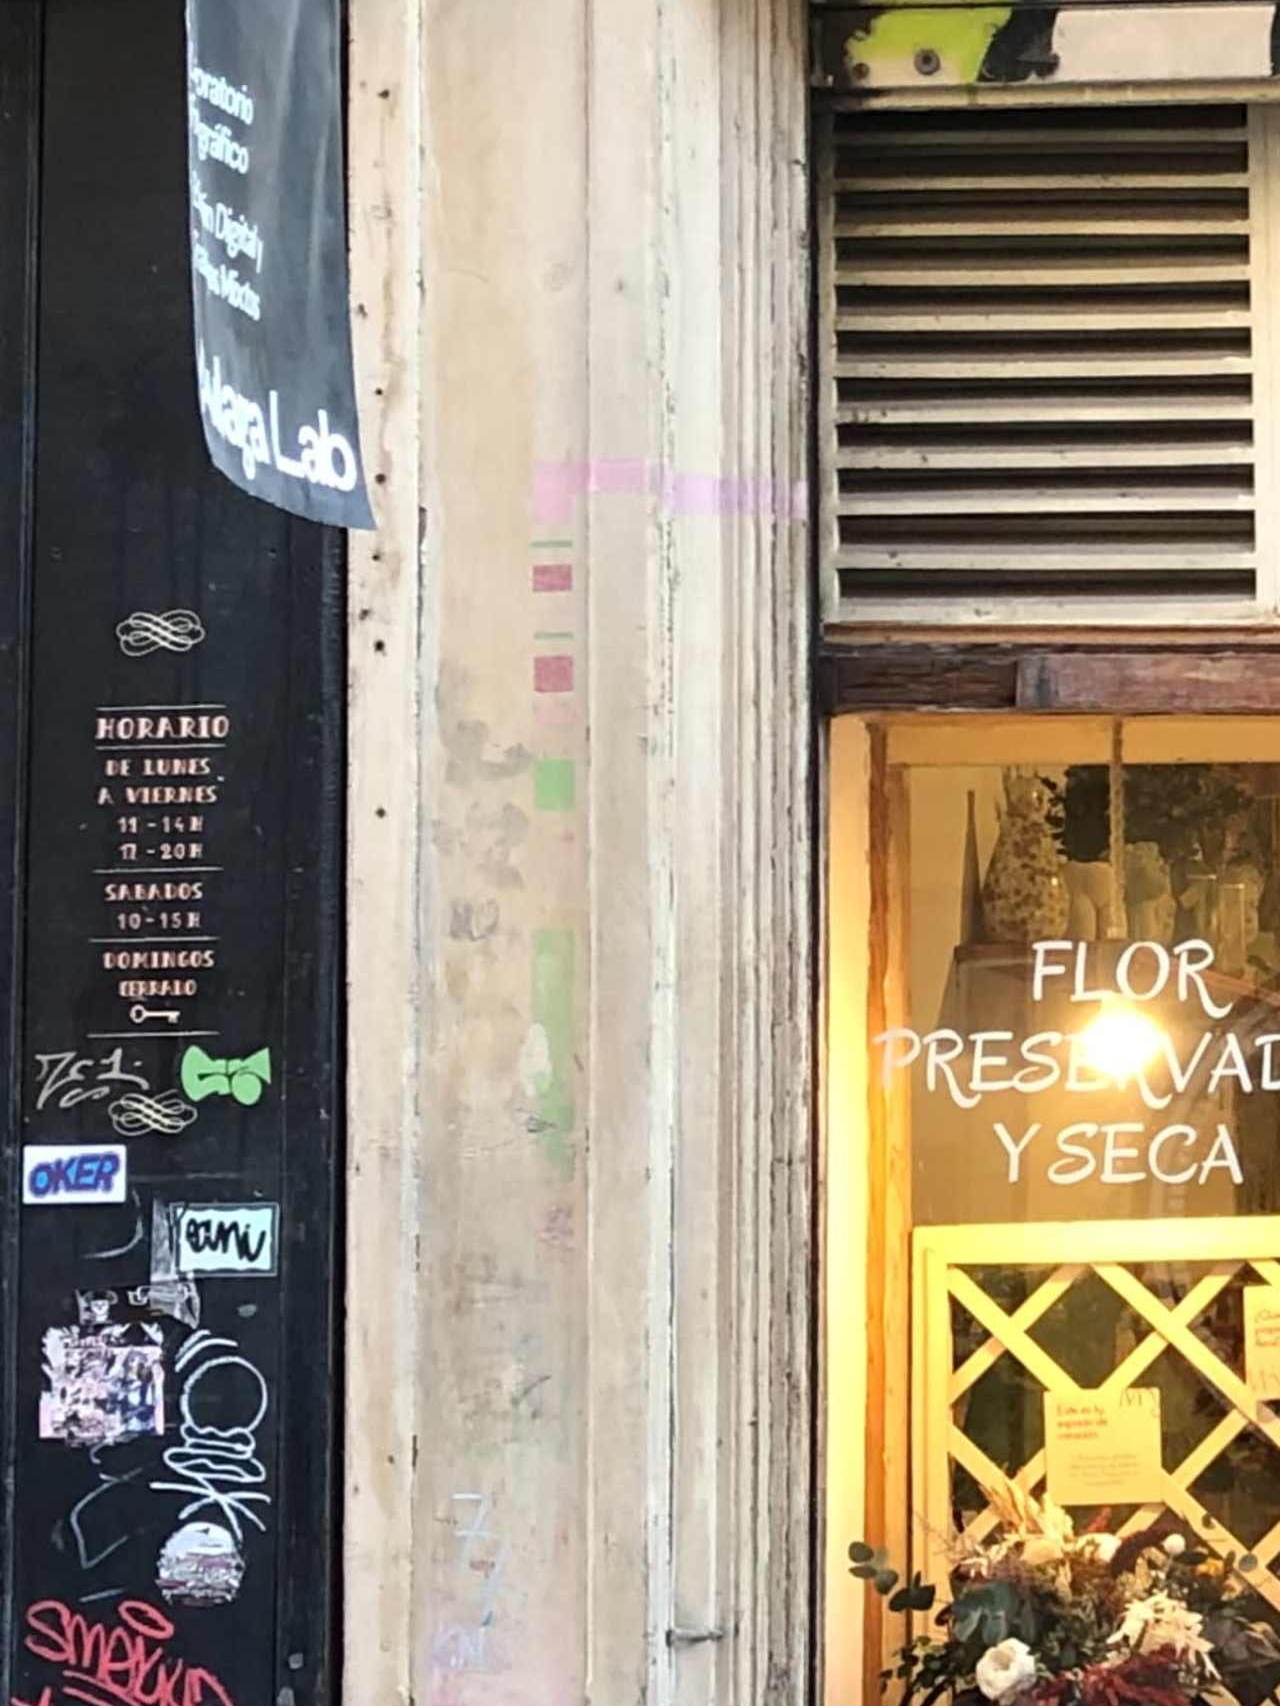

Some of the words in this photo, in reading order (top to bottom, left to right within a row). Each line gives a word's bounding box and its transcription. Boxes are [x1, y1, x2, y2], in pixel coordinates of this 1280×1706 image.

[269, 389, 358, 493] Lab
[95, 715, 230, 740] HORARIO
[105, 758, 131, 777] DE
[143, 757, 211, 776] LUNES
[97, 786, 115, 805] A
[125, 784, 218, 804] VIERNES
[104, 882, 204, 902] SABADOS
[102, 949, 216, 970] DOMINGOS
[1029, 938, 1234, 1019] FLOR
